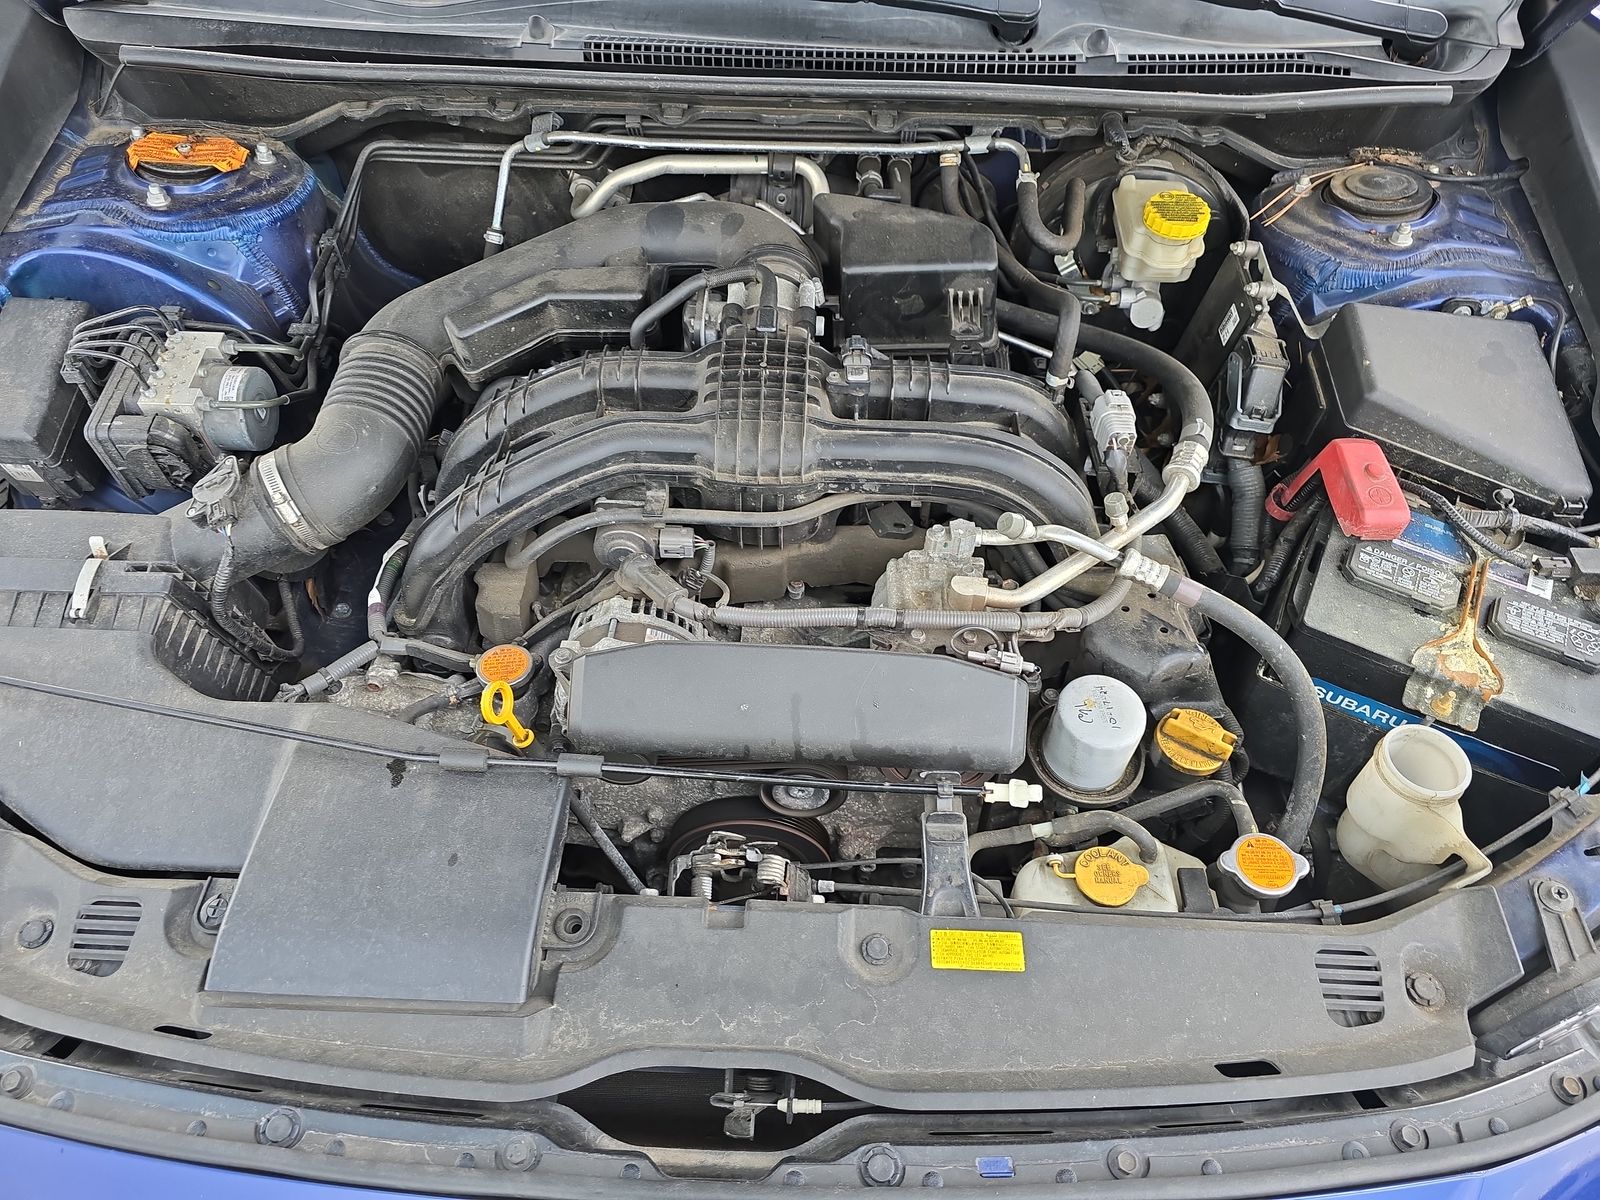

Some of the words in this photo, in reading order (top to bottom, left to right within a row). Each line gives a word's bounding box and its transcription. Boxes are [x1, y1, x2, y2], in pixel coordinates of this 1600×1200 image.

[1373, 548, 1408, 565] DANGER
[1415, 563, 1448, 580] POISON
[1314, 686, 1408, 728] SUBARU
[1079, 848, 1130, 868] COOLANT
